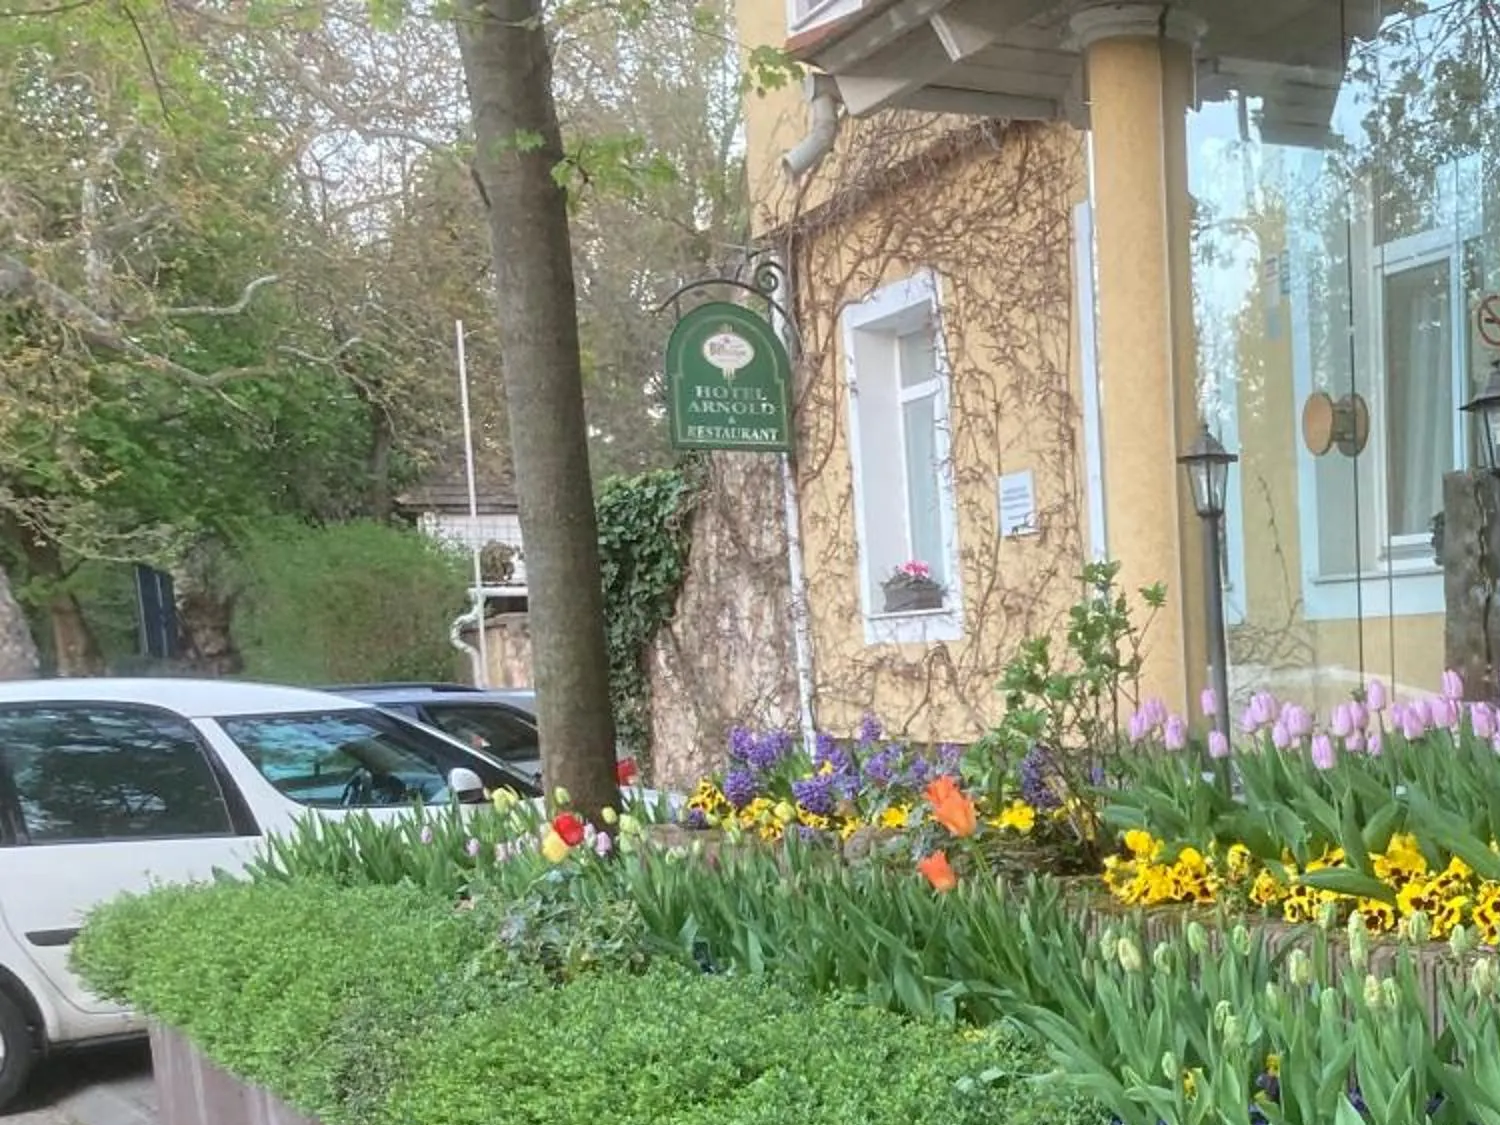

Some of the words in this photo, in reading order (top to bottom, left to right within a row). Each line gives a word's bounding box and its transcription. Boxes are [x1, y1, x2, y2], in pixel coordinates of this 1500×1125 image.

[694, 385, 768, 401] HOTEL
[687, 400, 776, 415] ARNOLD
[687, 425, 779, 441] RESTAURANT
